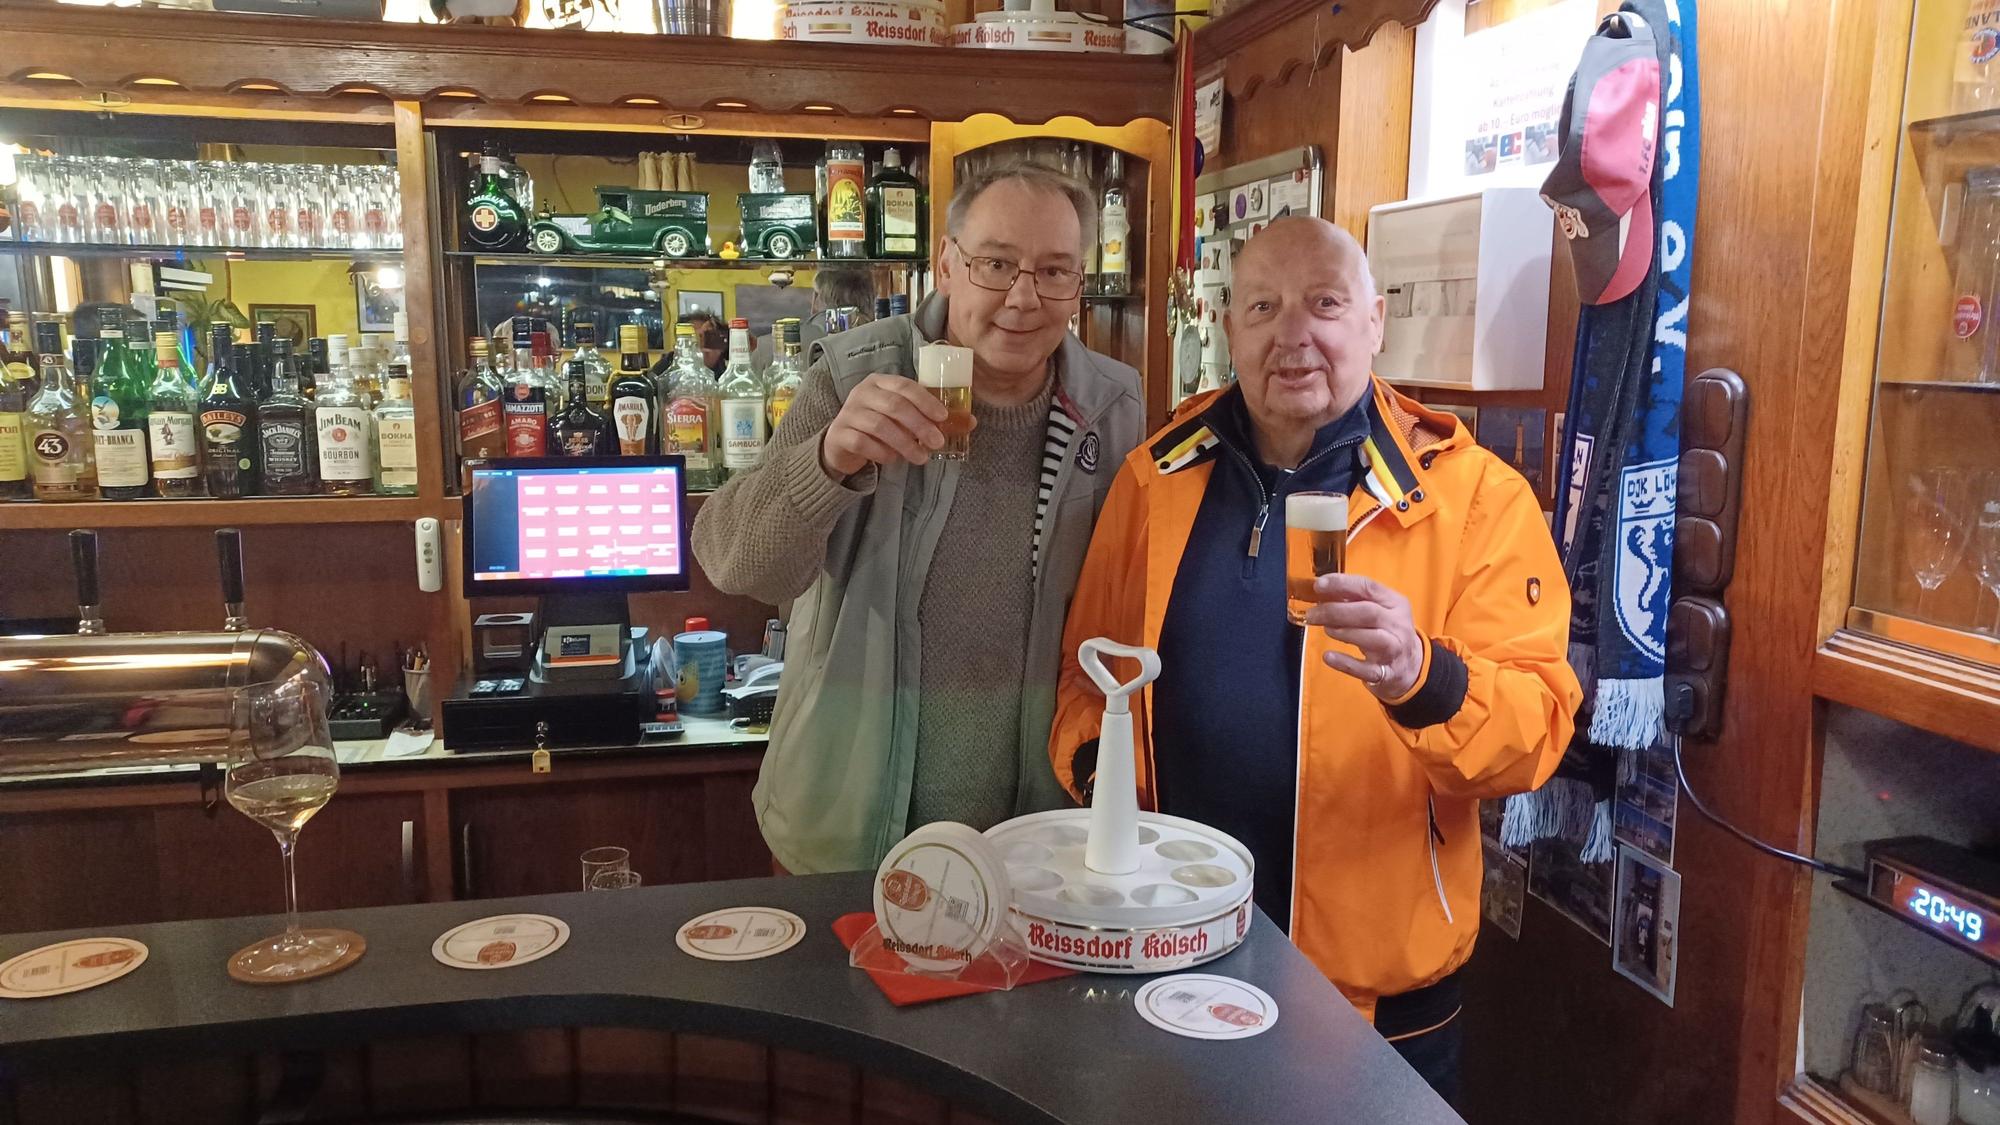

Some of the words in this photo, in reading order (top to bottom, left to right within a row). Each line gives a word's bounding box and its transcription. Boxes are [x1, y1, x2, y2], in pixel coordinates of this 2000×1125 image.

[866, 21, 926, 43] Reissdorf
[975, 26, 1015, 44] Kölsch
[1510, 112, 1529, 126] Euro
[645, 199, 687, 216] Underberg
[617, 402, 644, 413] AMARULA
[202, 411, 243, 425] BAILEYS
[319, 416, 335, 431] JIM
[335, 413, 361, 432] BEAM
[511, 418, 537, 426] AMARO
[667, 412, 703, 424] SIERRA
[381, 432, 414, 440] BOKMA
[37, 438, 63, 454] 43
[728, 440, 761, 449] SAMBUCA
[323, 450, 360, 460] BOURBON
[1627, 477, 1648, 498] DJK
[1914, 888, 1982, 941] 20:49
[1028, 922, 1133, 960] Reissdorf
[1141, 926, 1208, 960] Kölsch
